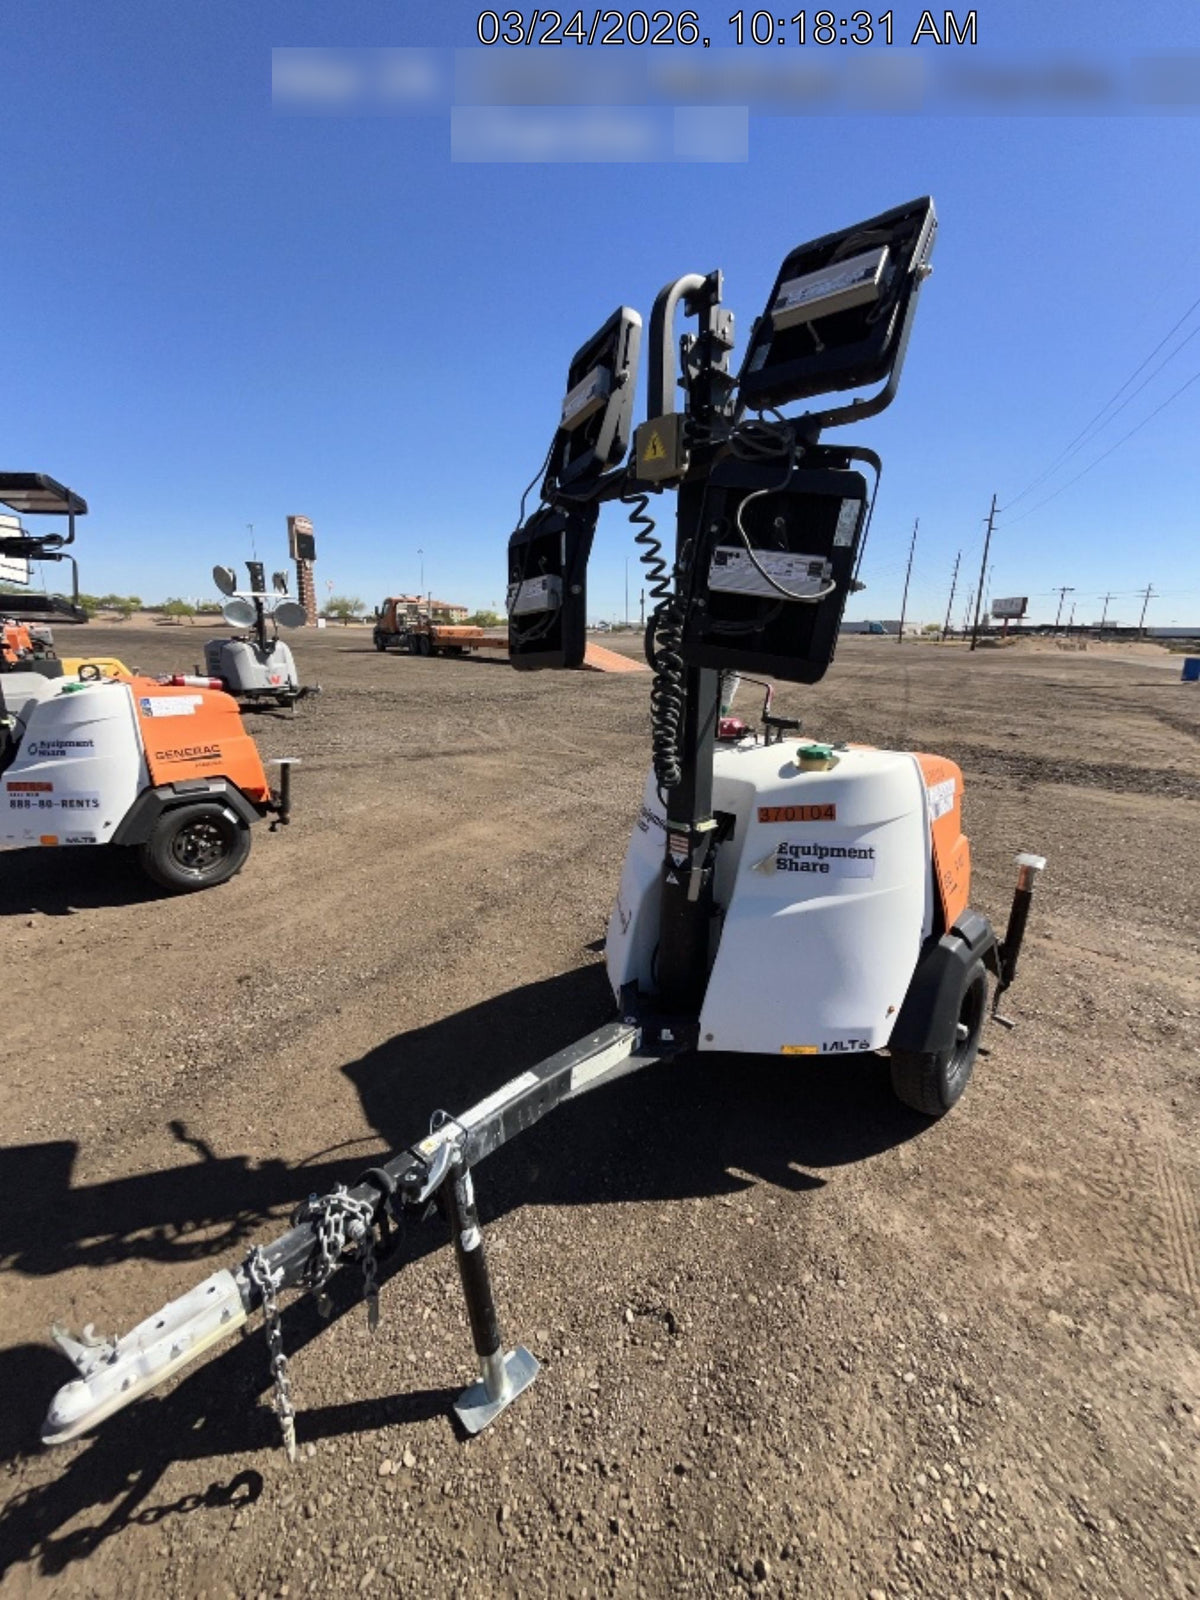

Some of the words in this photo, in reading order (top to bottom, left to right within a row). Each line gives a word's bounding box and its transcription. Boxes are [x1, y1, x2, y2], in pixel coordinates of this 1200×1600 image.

[155, 744, 221, 760] GENERAC
[9, 799, 99, 809] 888-80-RENTS
[759, 804, 835, 822] 370104
[777, 841, 876, 860] Equipment
[776, 857, 830, 874] Share
